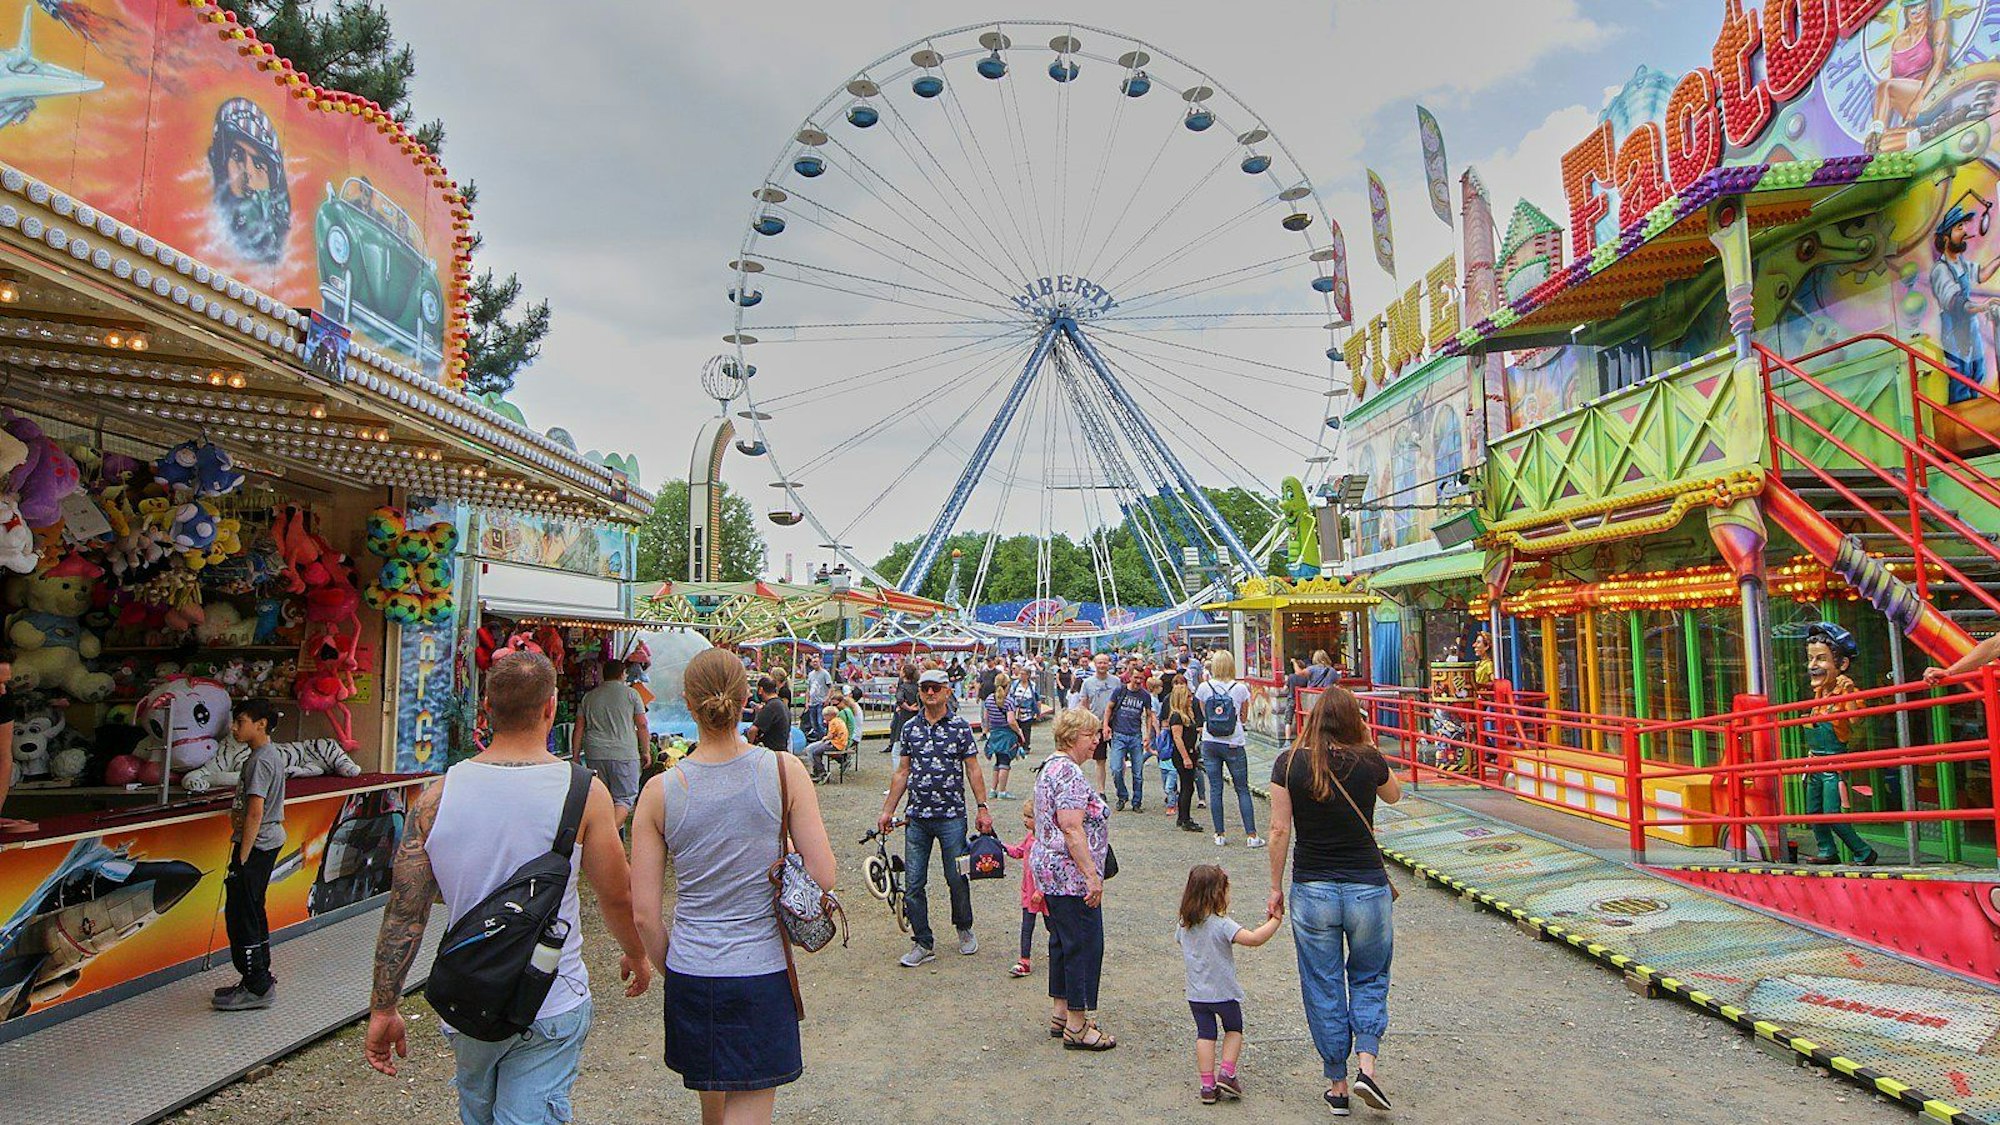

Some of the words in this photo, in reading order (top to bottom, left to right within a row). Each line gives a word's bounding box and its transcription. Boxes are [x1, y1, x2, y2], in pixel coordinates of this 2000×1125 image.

[1561, 0, 1886, 260] Facto
[1010, 274, 1119, 314] LIBERTY
[1343, 252, 1461, 402] TIME
[1797, 991, 1950, 1029] DANGER
